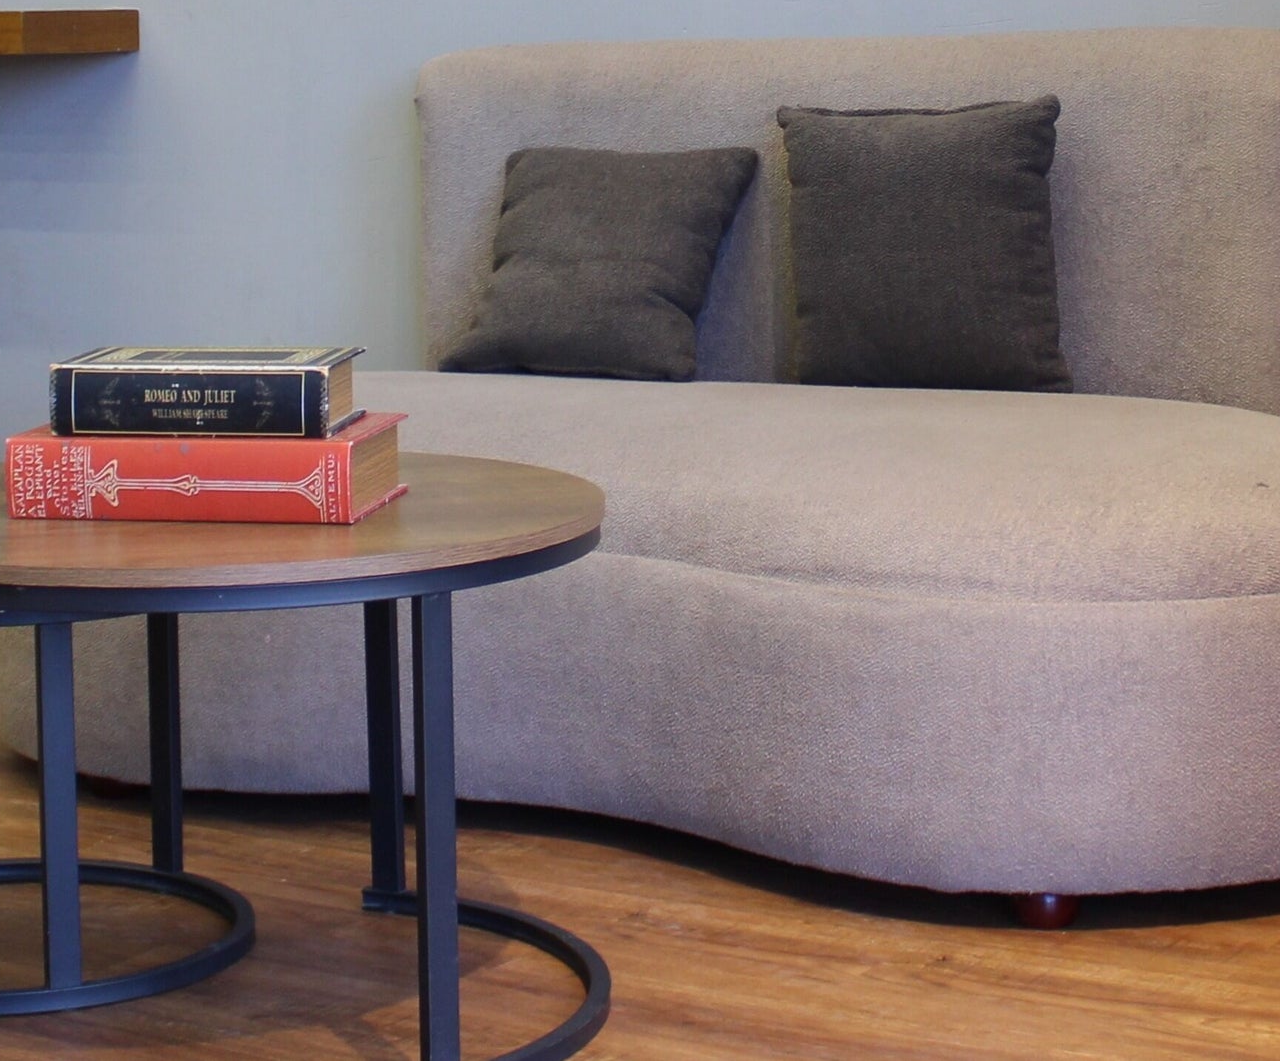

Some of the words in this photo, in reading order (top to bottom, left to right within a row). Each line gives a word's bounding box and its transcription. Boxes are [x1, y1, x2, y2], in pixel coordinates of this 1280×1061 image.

[143, 388, 178, 403] ROMEO
[180, 389, 201, 403] AND
[203, 388, 237, 406] JULIET
[152, 408, 182, 419] WILLIAM
[25, 444, 35, 500] ROGUE
[35, 444, 46, 518] ELEPHANT
[27, 505, 37, 518] A
